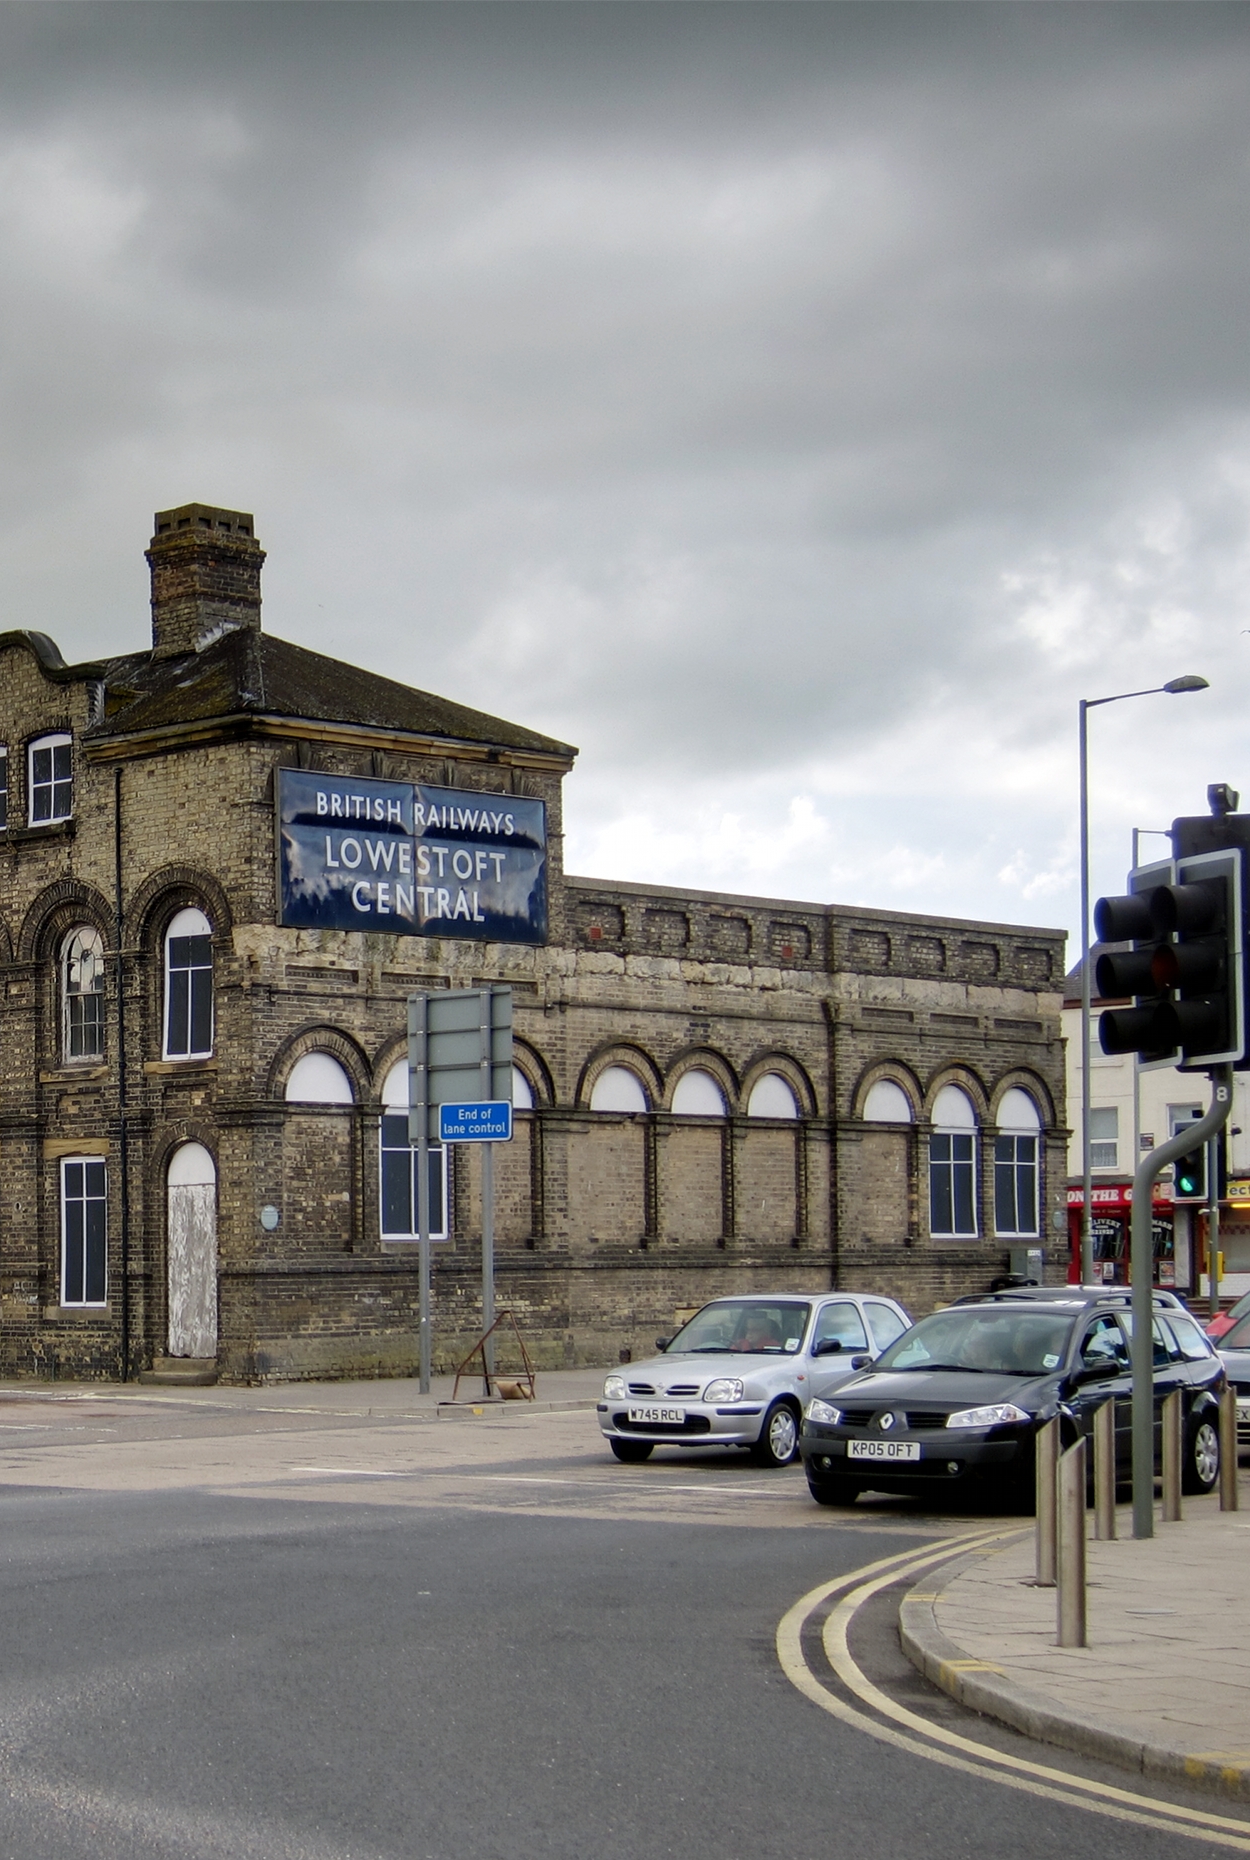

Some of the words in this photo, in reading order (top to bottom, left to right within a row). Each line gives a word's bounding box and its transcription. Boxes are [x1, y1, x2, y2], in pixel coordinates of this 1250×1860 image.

[317, 791, 401, 822] BRITISH
[414, 803, 514, 835] RAILWAYS
[325, 835, 506, 882] LOWESTOFT
[352, 880, 485, 922] CENTRAL
[1216, 1086, 1228, 1102] 8
[458, 1108, 478, 1120] End
[481, 1108, 492, 1119] of
[444, 1123, 465, 1134] lane
[468, 1121, 506, 1133] control
[1091, 1189, 1119, 1201] THE
[1124, 1189, 1132, 1200] G
[631, 1409, 659, 1420] W745
[661, 1410, 682, 1421] RCL
[852, 1442, 884, 1456] KP05
[887, 1444, 913, 1457] OFT
